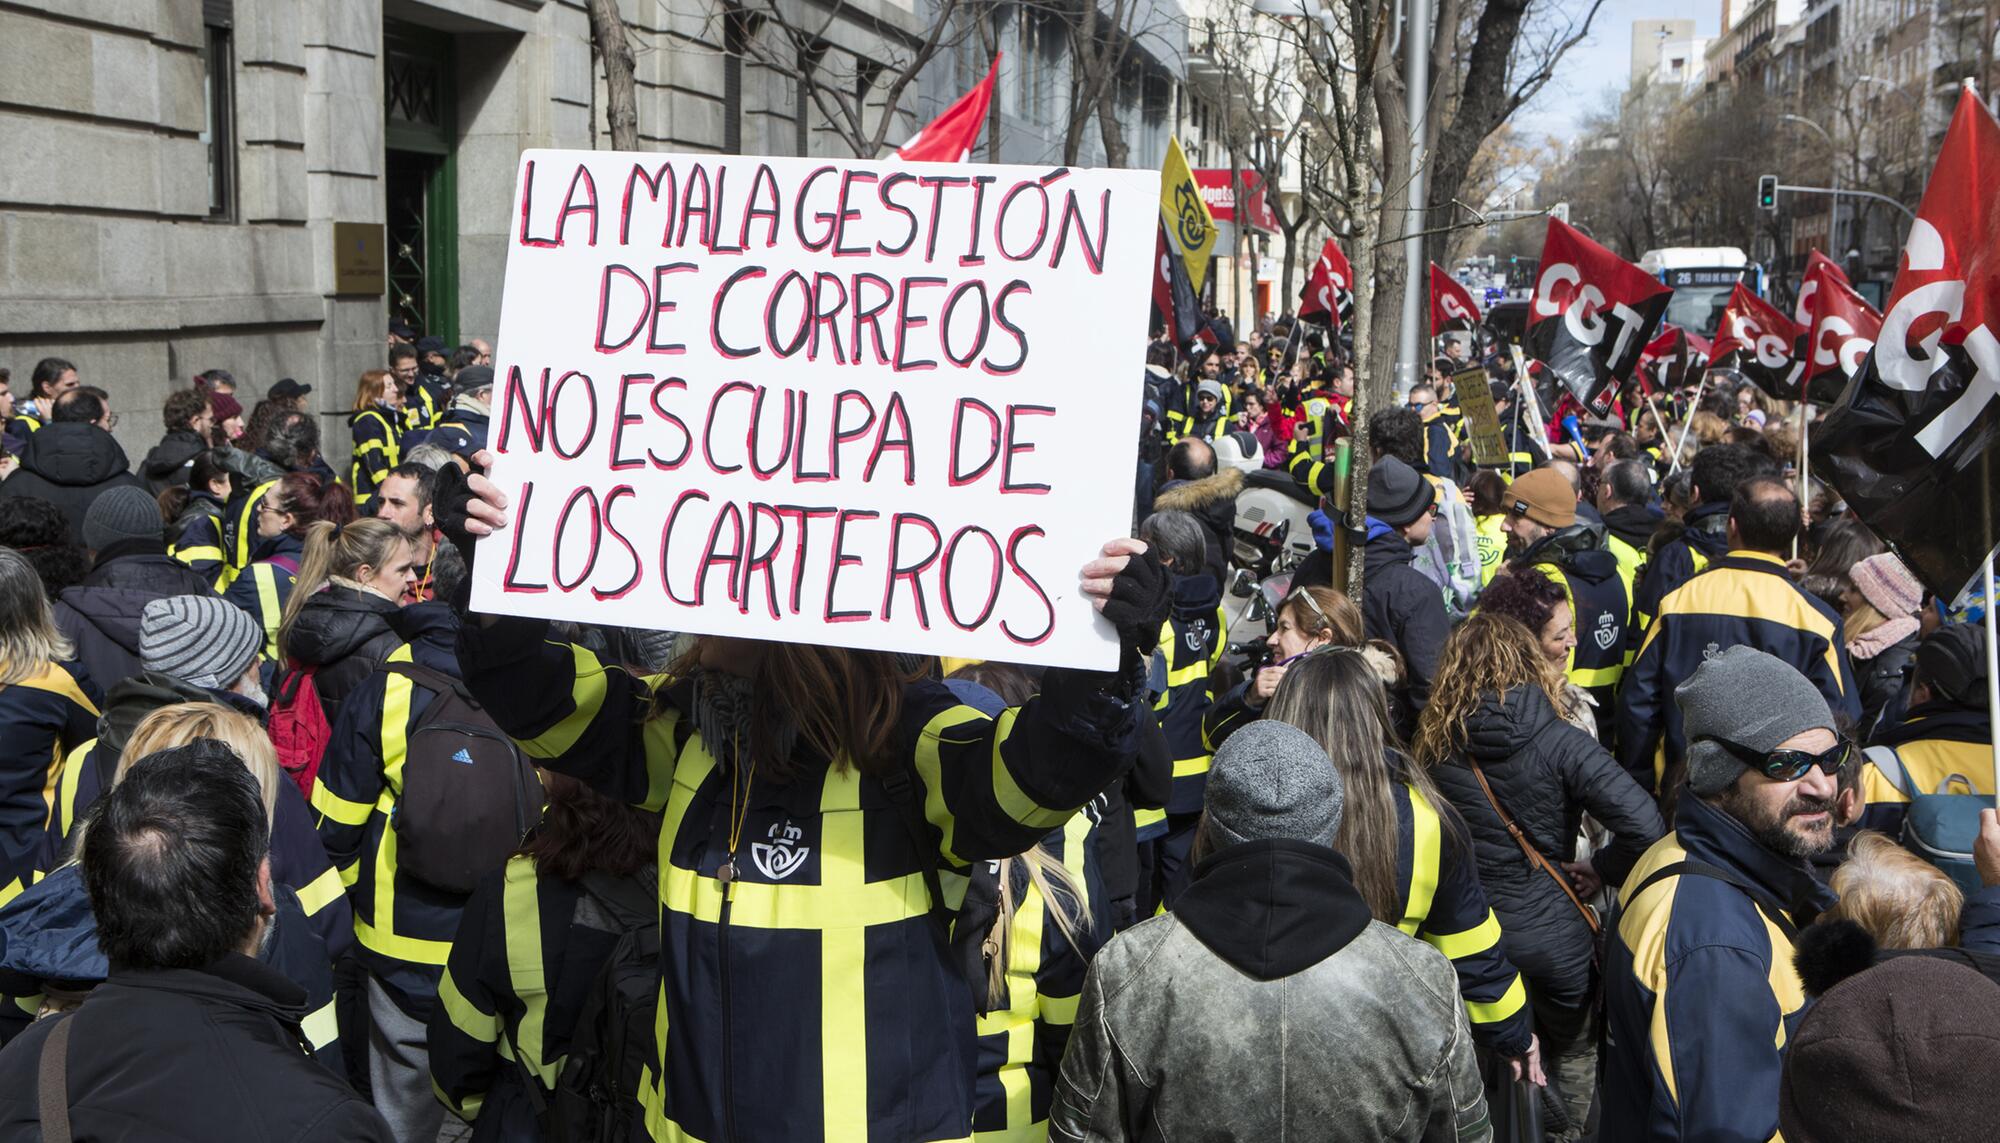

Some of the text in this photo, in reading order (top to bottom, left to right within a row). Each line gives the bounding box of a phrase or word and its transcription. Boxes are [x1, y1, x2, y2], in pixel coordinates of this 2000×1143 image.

[520, 161, 1111, 274] LA MALA GESTIÓN
[595, 262, 1031, 375] DE CORREOS
[1535, 262, 1645, 370] CGT
[1677, 272, 1692, 285] 26
[497, 365, 1055, 494] NO ES CULPA DE
[503, 482, 1054, 646] LOS CARTEROS
